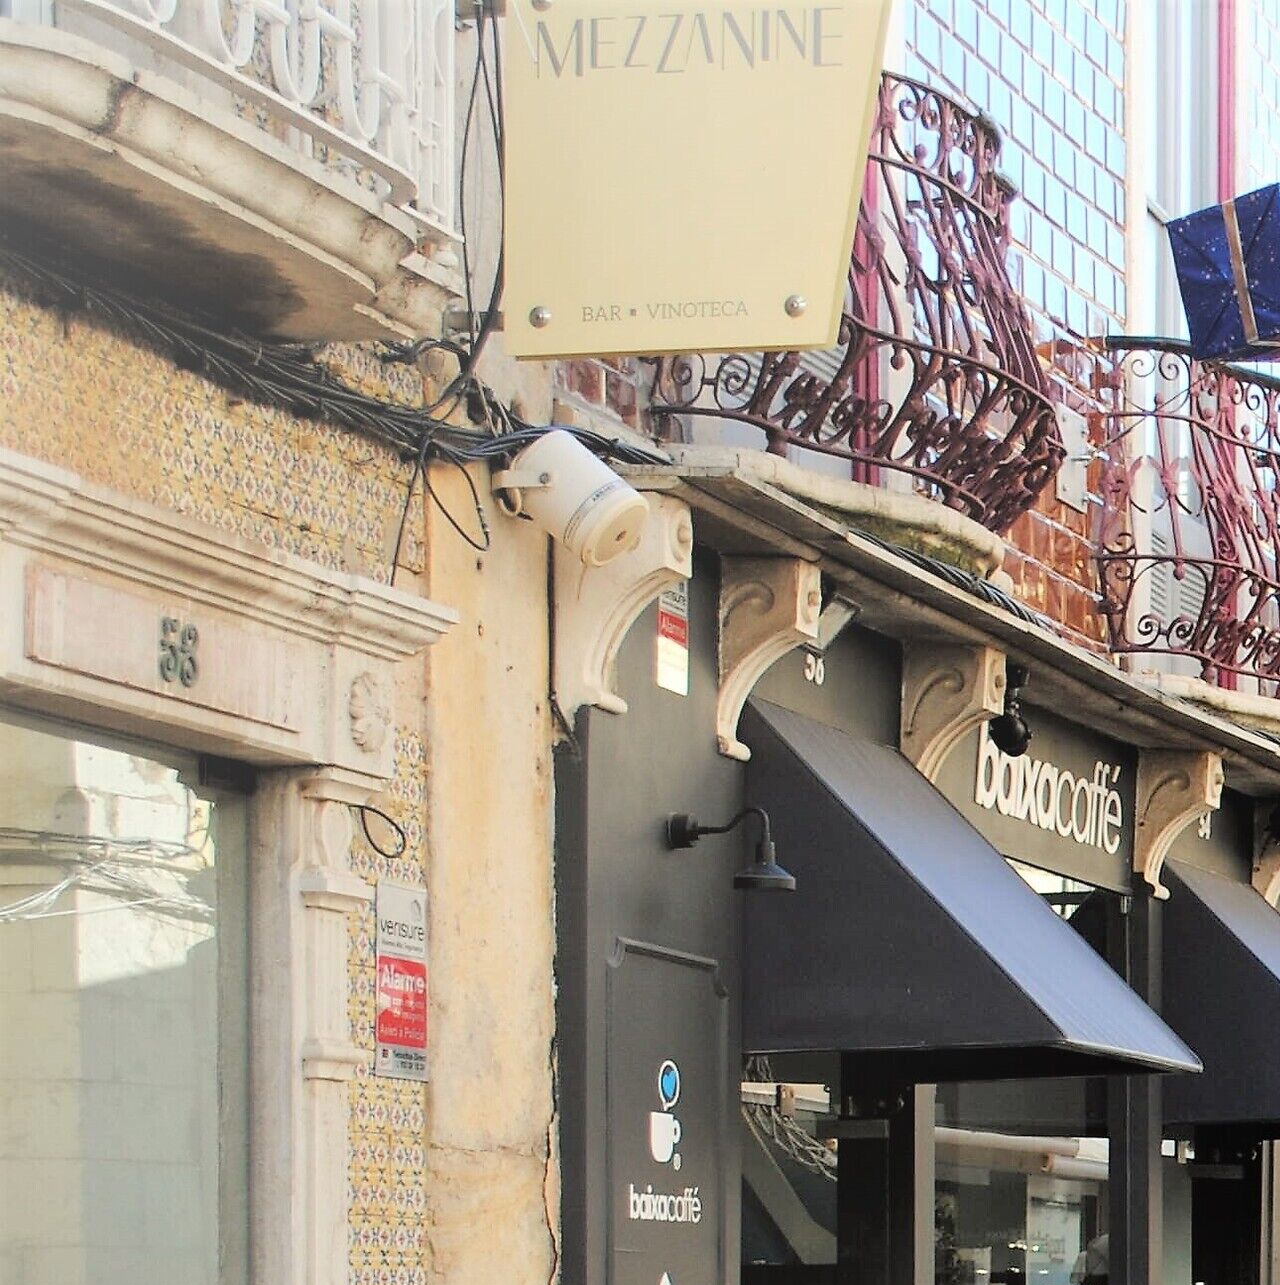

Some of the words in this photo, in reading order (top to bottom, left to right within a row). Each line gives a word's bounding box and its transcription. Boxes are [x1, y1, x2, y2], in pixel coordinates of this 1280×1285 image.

[536, 8, 844, 79] MEZZANINE
[581, 306, 623, 323] BAR
[646, 300, 749, 322] VINOTECA
[974, 720, 1123, 855] baixacaffé
[380, 963, 426, 995] Alarme
[629, 1183, 702, 1223] baixacaffé
